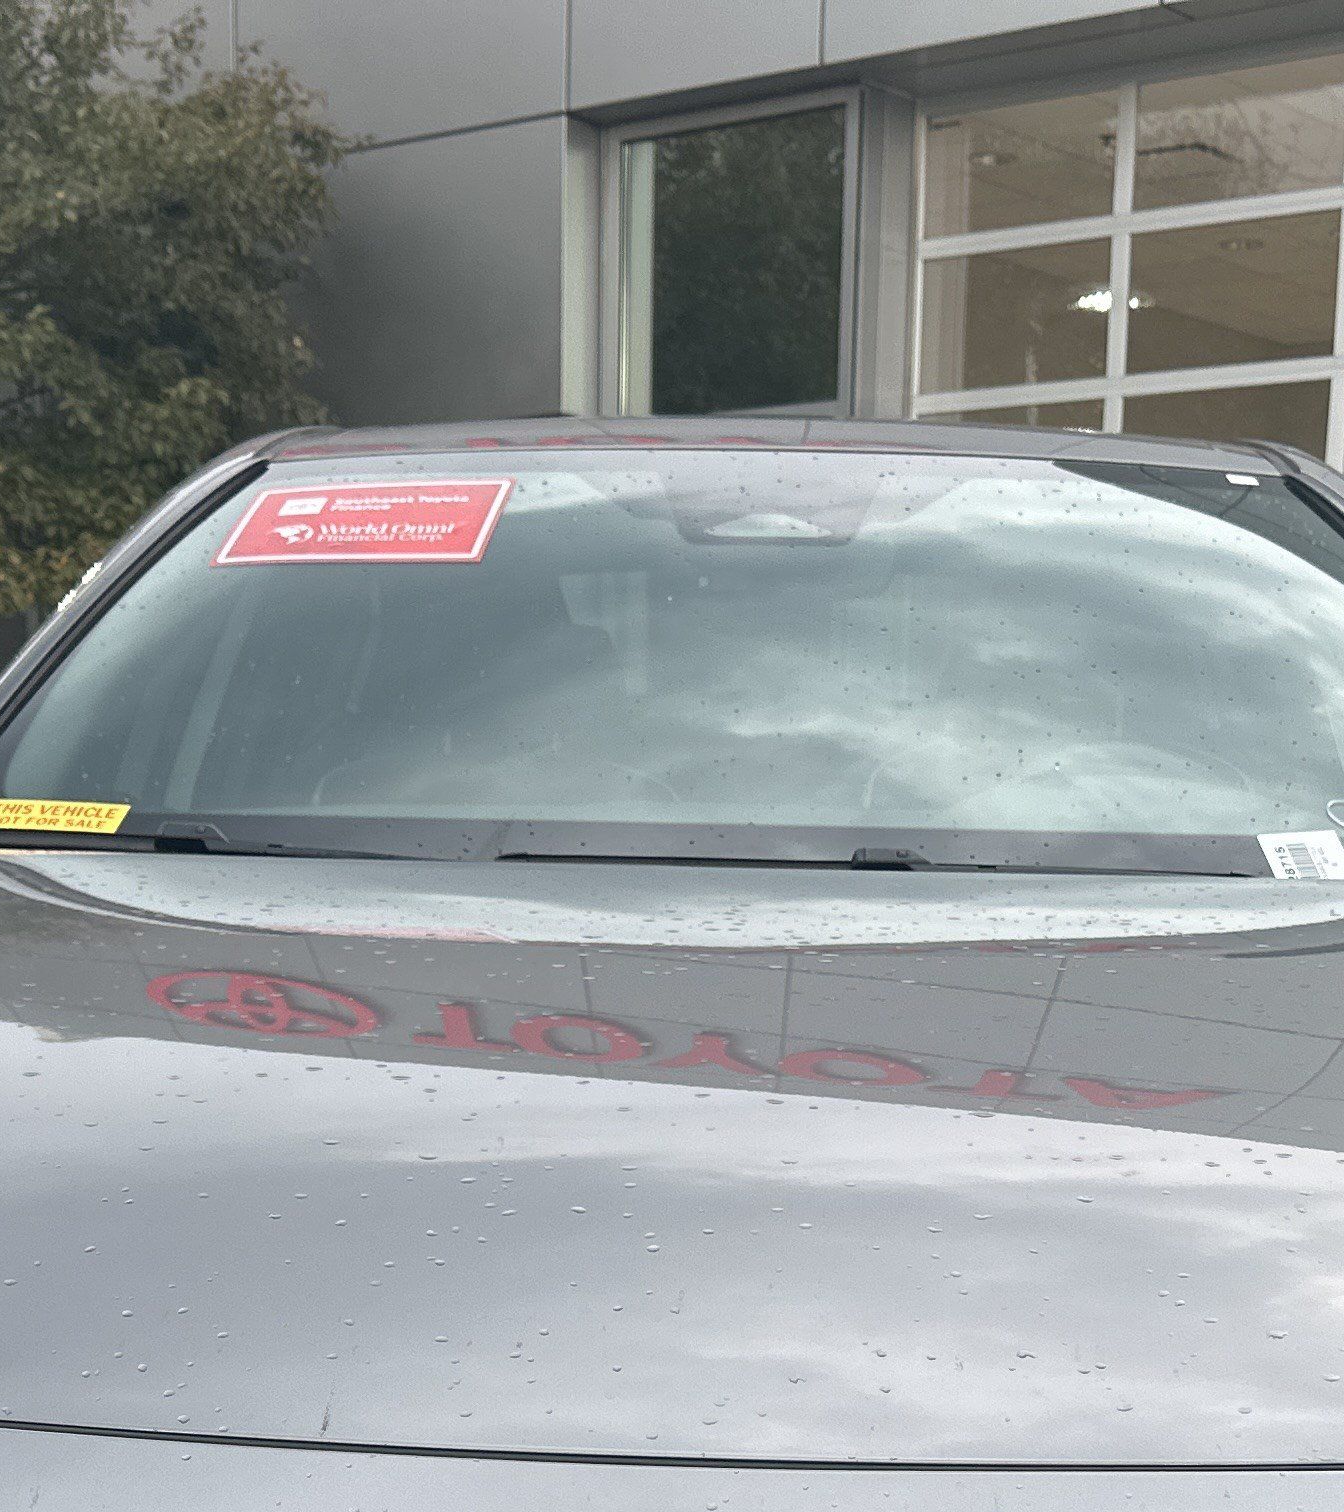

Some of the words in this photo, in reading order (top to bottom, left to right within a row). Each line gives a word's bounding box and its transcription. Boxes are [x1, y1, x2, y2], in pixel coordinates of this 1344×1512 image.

[319, 523, 387, 535] World
[40, 804, 119, 820] VEHICLE
[25, 817, 58, 827] FOR
[64, 818, 106, 829] SALE
